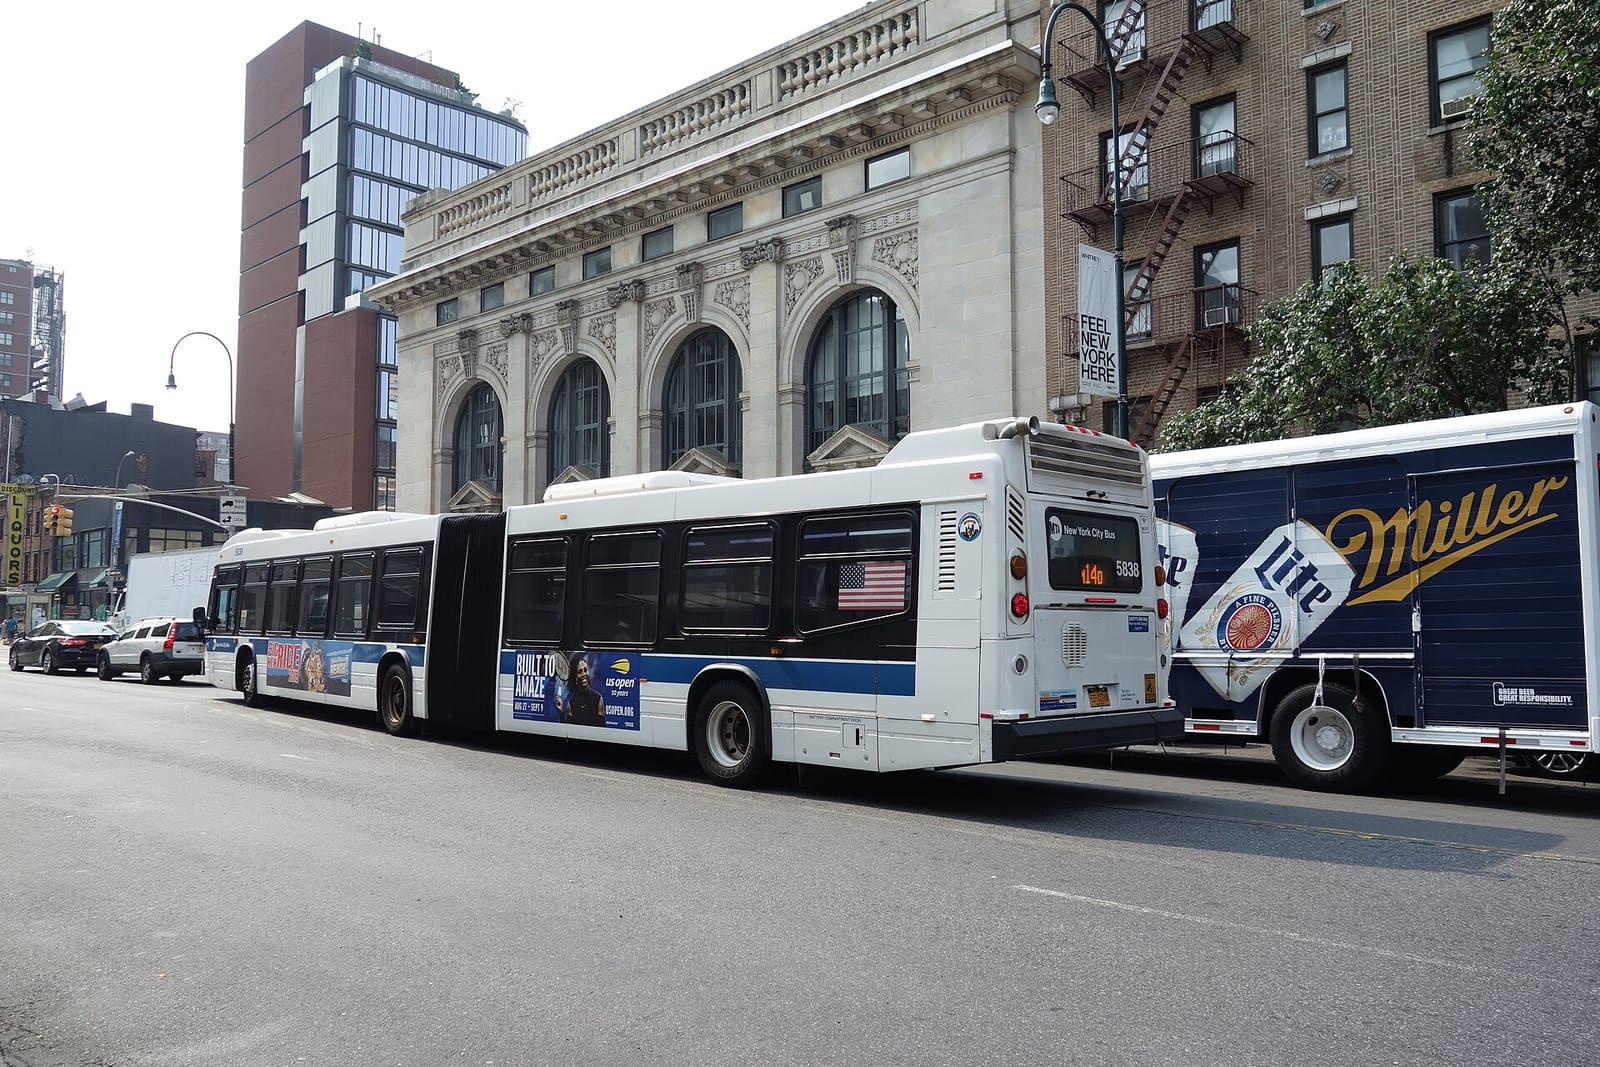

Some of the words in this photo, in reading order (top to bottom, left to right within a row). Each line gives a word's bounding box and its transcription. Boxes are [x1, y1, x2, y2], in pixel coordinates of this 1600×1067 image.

[1081, 253, 1100, 261] WHITNEY
[1081, 314, 1111, 335] FEEL
[1081, 331, 1110, 350] NEW
[1081, 347, 1116, 368] YORK
[1081, 363, 1115, 383] HERE
[1, 486, 36, 494] DISCOUNT
[8, 496, 22, 584] LIQUORS
[1063, 525, 1077, 535] New
[1077, 526, 1091, 537] York
[1091, 527, 1103, 539] City
[1104, 529, 1116, 539] Bus
[1325, 476, 1568, 589] Miller
[1116, 560, 1139, 578] 5838
[1158, 544, 1187, 587] te
[1254, 535, 1332, 613] Lite
[1243, 595, 1266, 604] FINE
[1267, 601, 1281, 643] PILSNER
[278, 644, 300, 669] RIDE
[516, 654, 542, 676] BUILT
[544, 654, 556, 678] TO
[515, 676, 545, 698] AMAZE
[605, 678, 615, 687] us
[615, 679, 635, 690] open
[531, 703, 540, 712] SEPT
[605, 705, 634, 717] USOPEN.ORG
